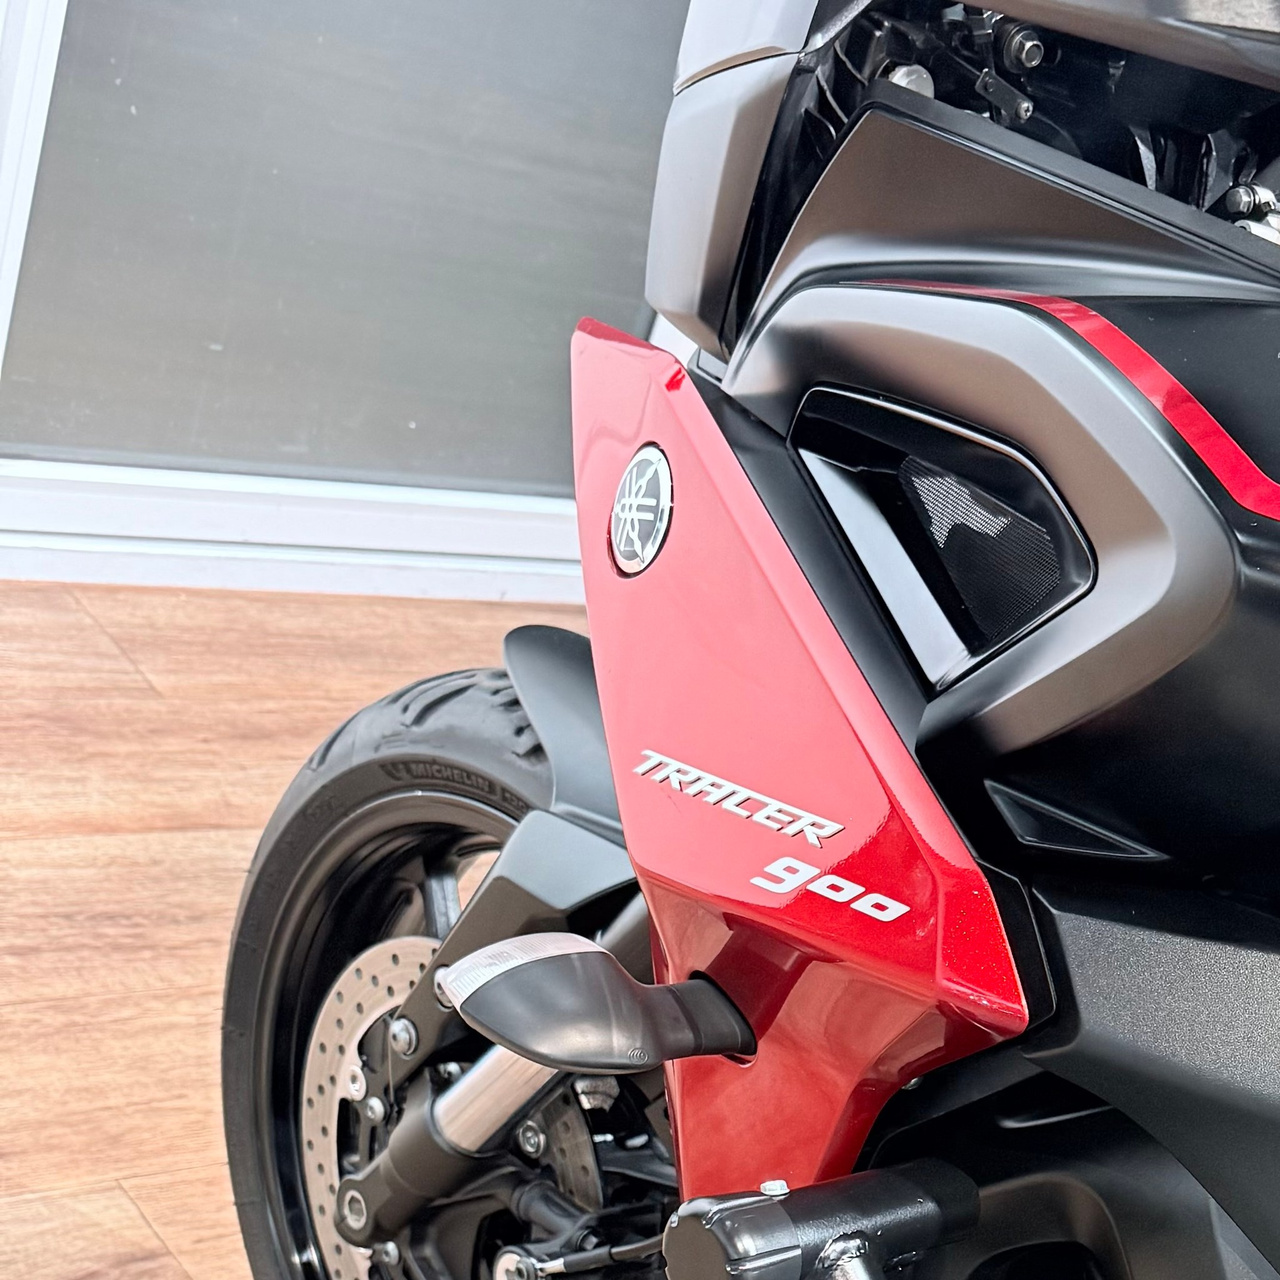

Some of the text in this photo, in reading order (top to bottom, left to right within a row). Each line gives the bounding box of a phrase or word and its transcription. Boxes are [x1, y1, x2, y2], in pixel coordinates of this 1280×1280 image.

[411, 763, 492, 793] MICHELIN
[633, 750, 845, 848] TRACER
[750, 857, 911, 922] 900
